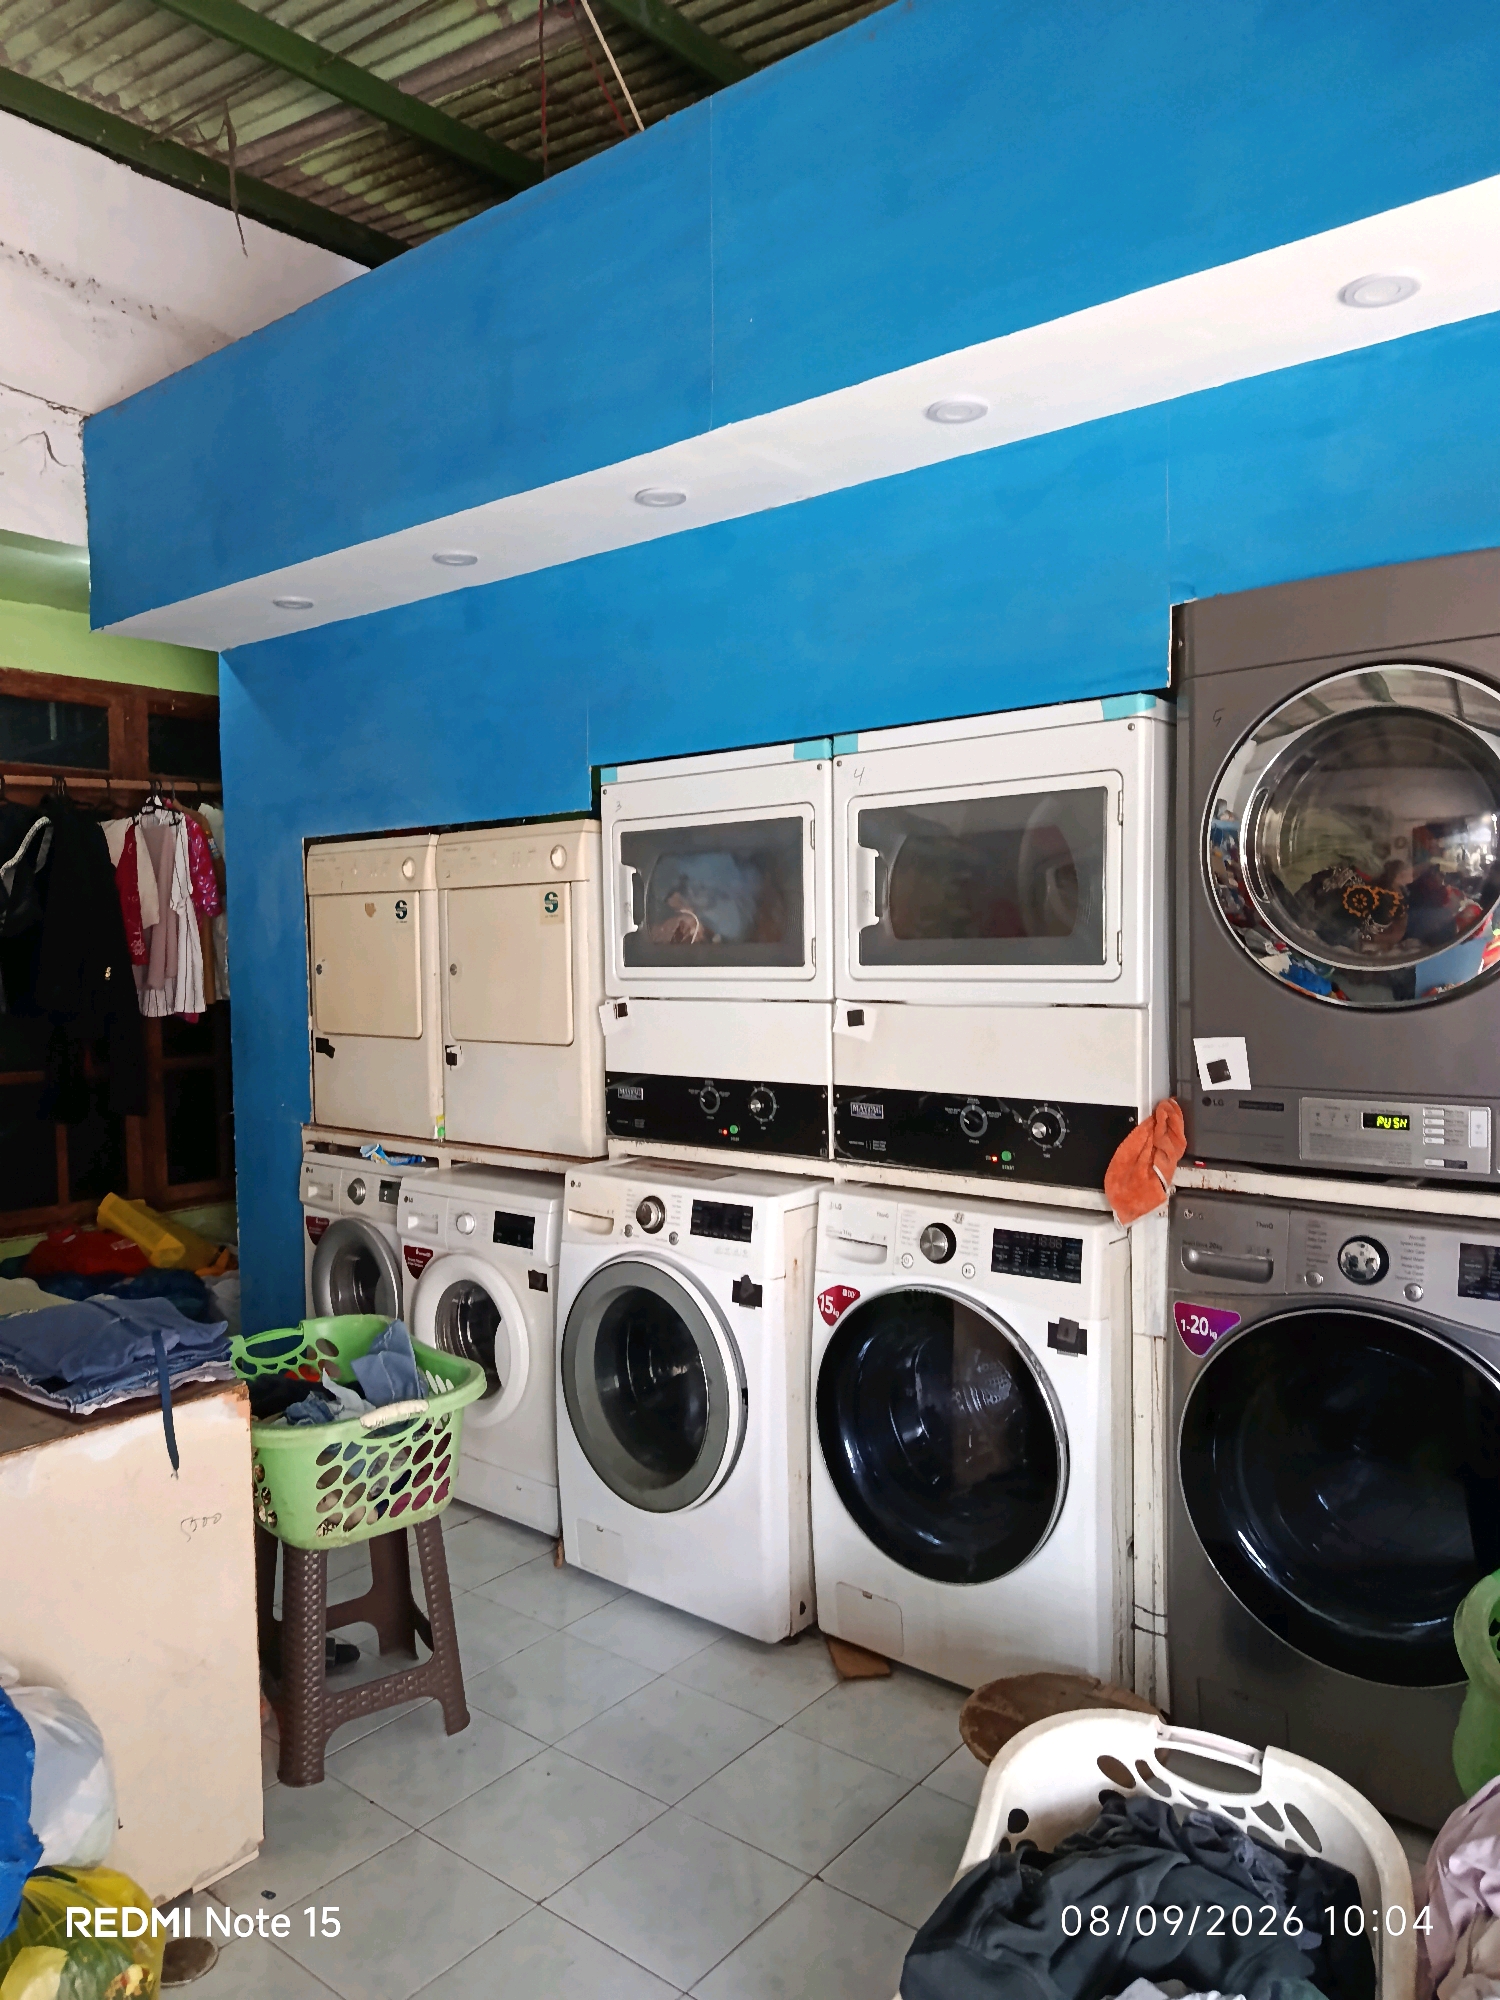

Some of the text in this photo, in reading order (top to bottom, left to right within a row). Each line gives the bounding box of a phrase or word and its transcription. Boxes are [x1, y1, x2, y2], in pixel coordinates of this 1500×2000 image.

[853, 766, 865, 787] 4
[1376, 1115, 1408, 1129] PUSH
[1255, 1221, 1274, 1230] ThinQ
